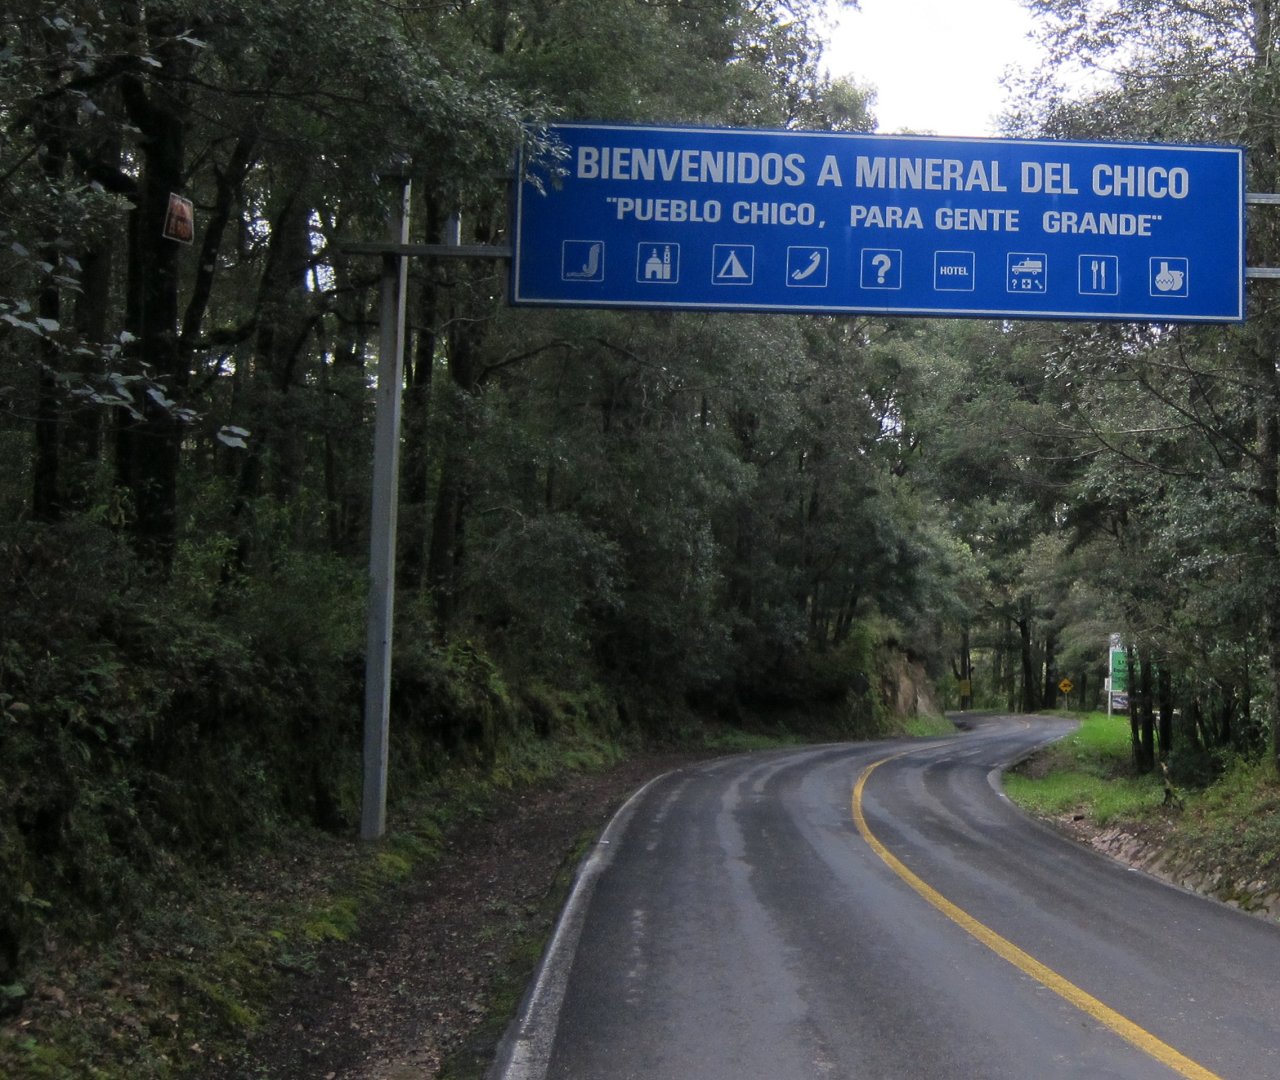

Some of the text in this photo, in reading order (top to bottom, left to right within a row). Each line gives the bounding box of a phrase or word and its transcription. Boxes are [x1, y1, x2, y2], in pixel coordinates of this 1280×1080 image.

[577, 146, 1189, 199] BIENVENIDOS A MINERAL DEL CHICO
[732, 201, 826, 229] CHICO,
[850, 205, 924, 230] PARA
[935, 207, 1020, 232] GENTE
[940, 266, 969, 276] HOTEL
